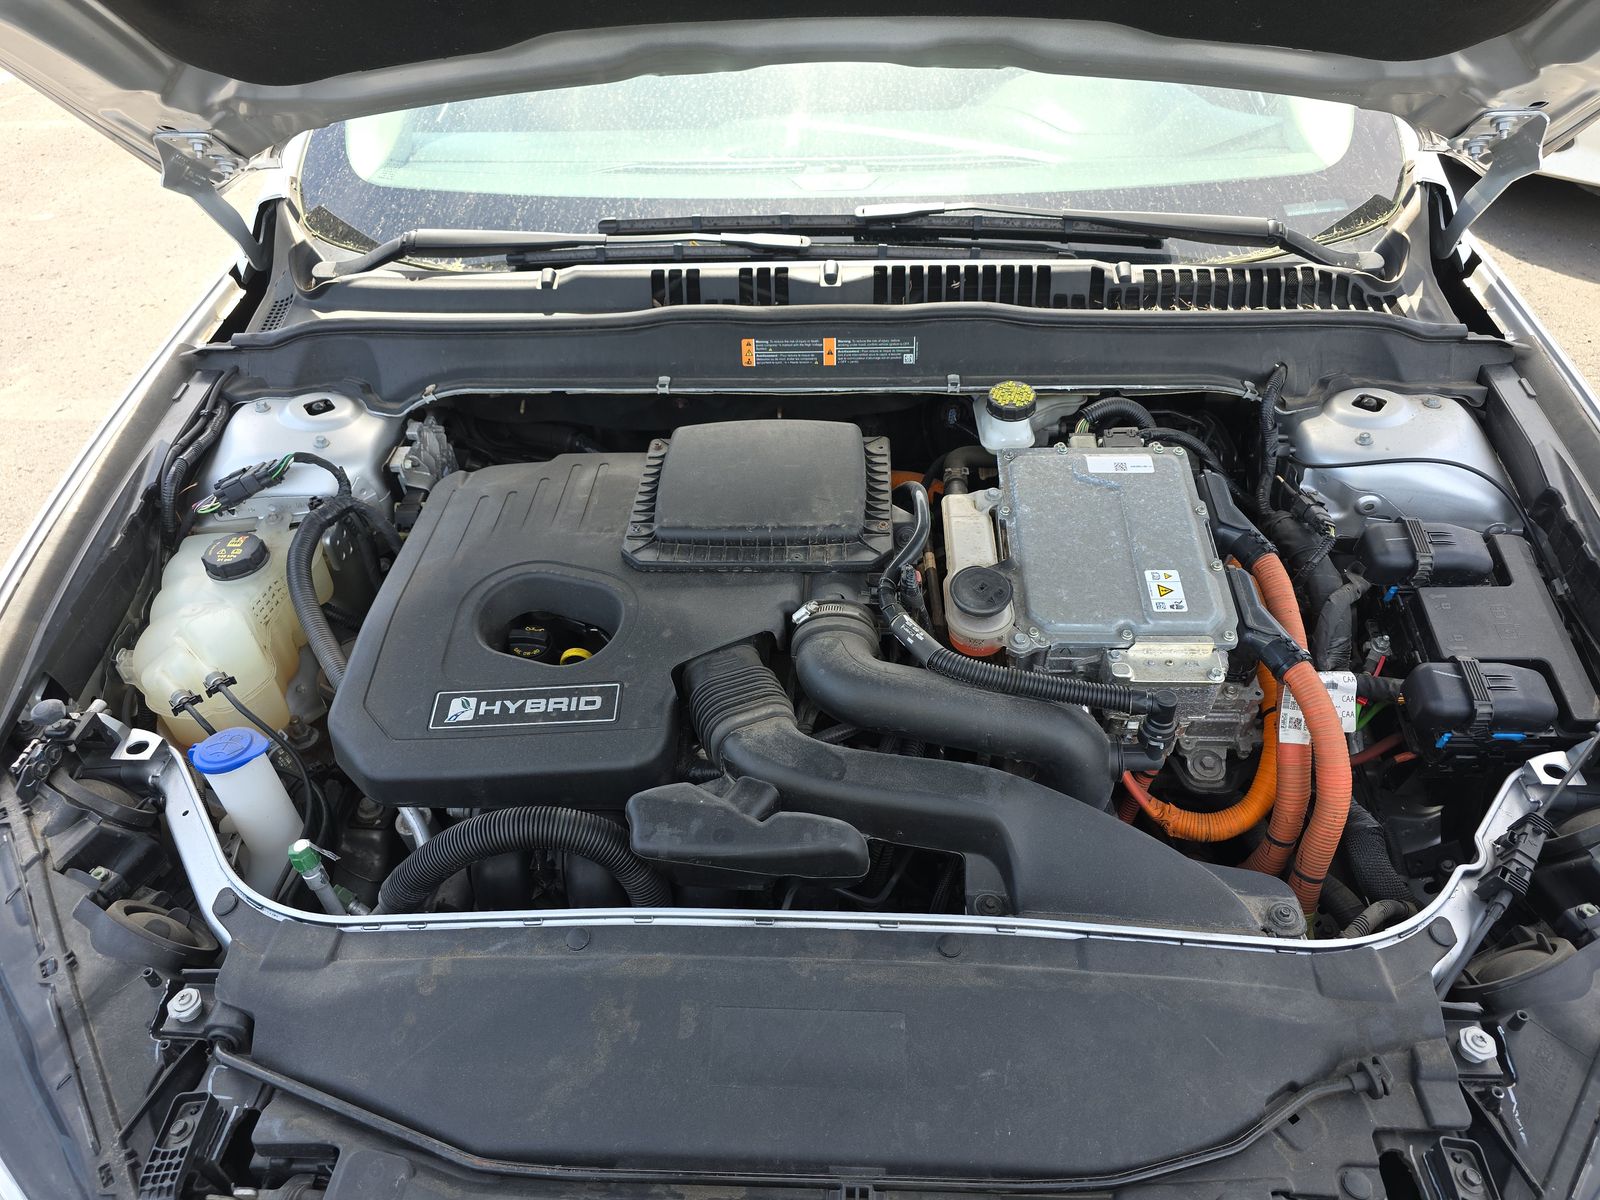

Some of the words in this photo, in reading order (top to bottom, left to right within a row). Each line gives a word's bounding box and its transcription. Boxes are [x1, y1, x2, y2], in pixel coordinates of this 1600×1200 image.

[1342, 675, 1356, 683] CAA
[1341, 695, 1355, 703] CAA
[478, 695, 602, 716] HYBRID
